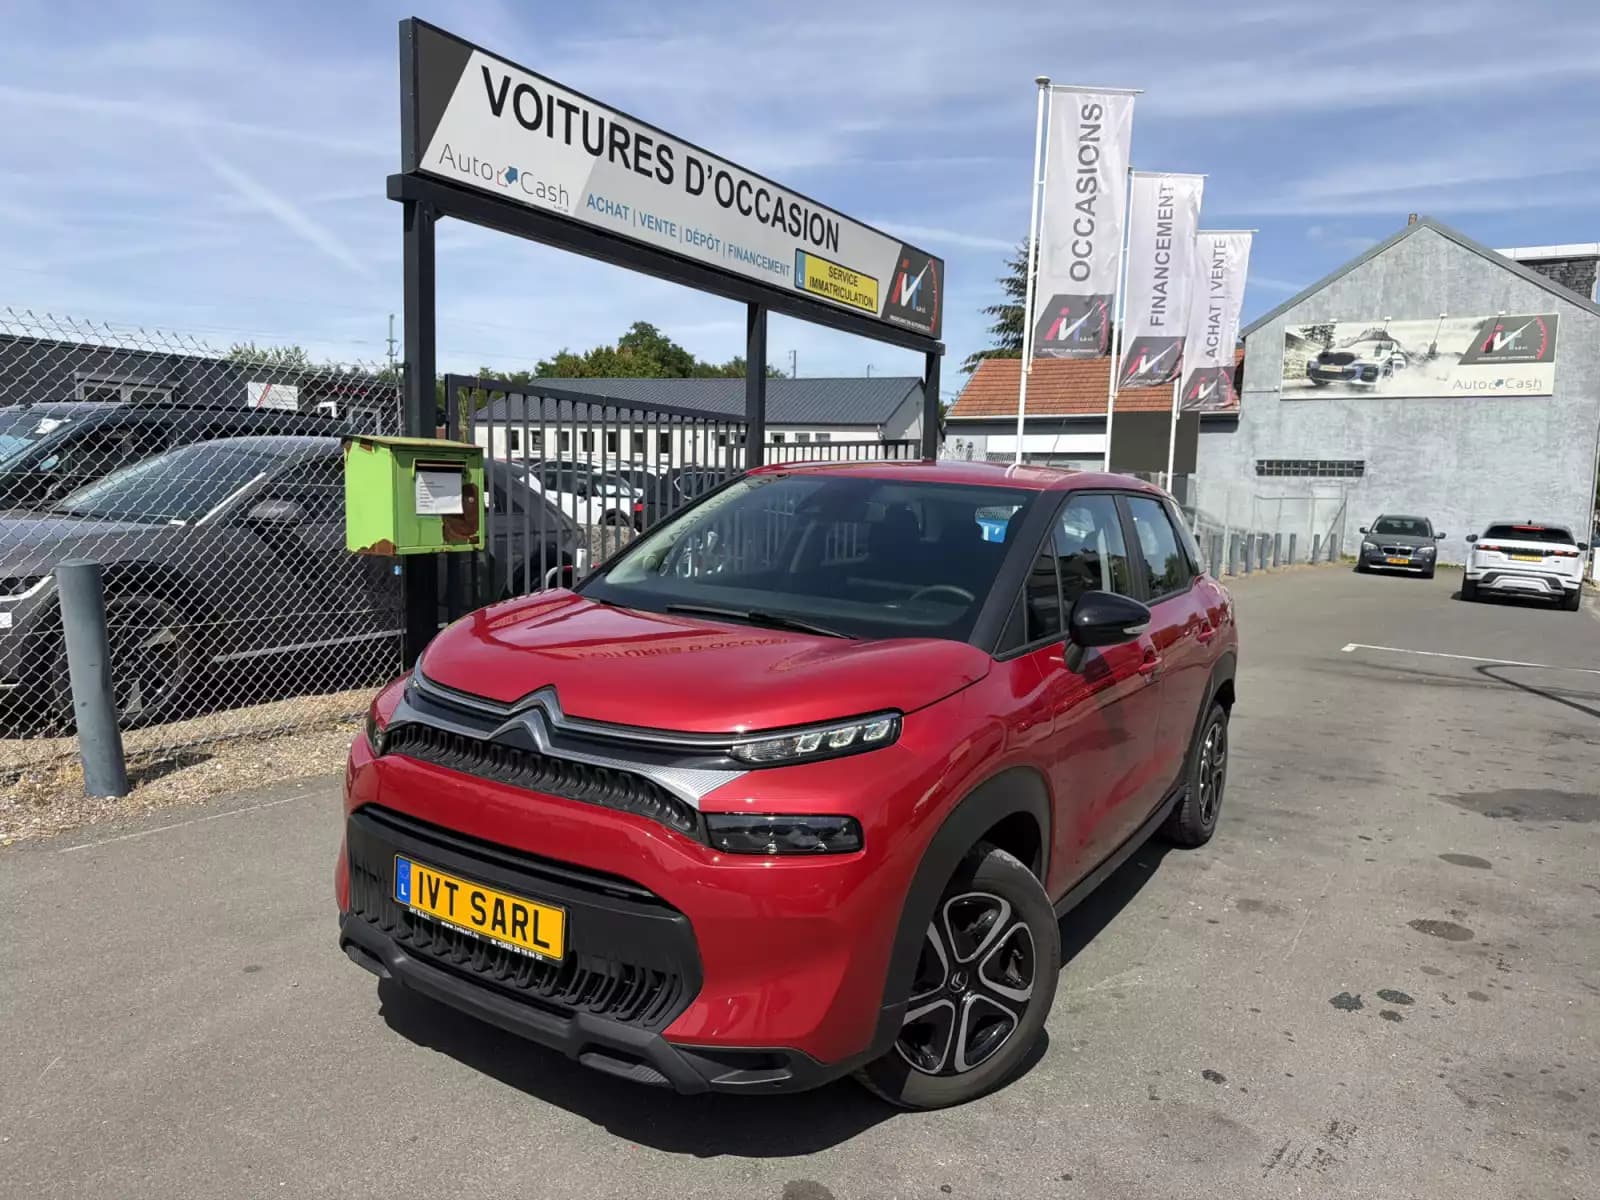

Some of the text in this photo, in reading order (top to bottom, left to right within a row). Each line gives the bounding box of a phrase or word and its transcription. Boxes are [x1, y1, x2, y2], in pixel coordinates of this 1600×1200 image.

[439, 143, 569, 207] Auto Cash
[481, 65, 839, 253] VOITURES D'OCCASION
[1068, 102, 1104, 283] OCCASIONS
[586, 193, 790, 277] ACHAT VENTE DÉPÔT FINANCEMENT
[1150, 181, 1174, 327] FINANCEMENT
[809, 275, 874, 308] IMMATRICULATION
[828, 265, 859, 287] SERVICE
[1206, 239, 1226, 358] ACHAT VENTE
[1453, 377, 1543, 391] Auto Cash
[400, 871, 551, 950] L IVT SARL
